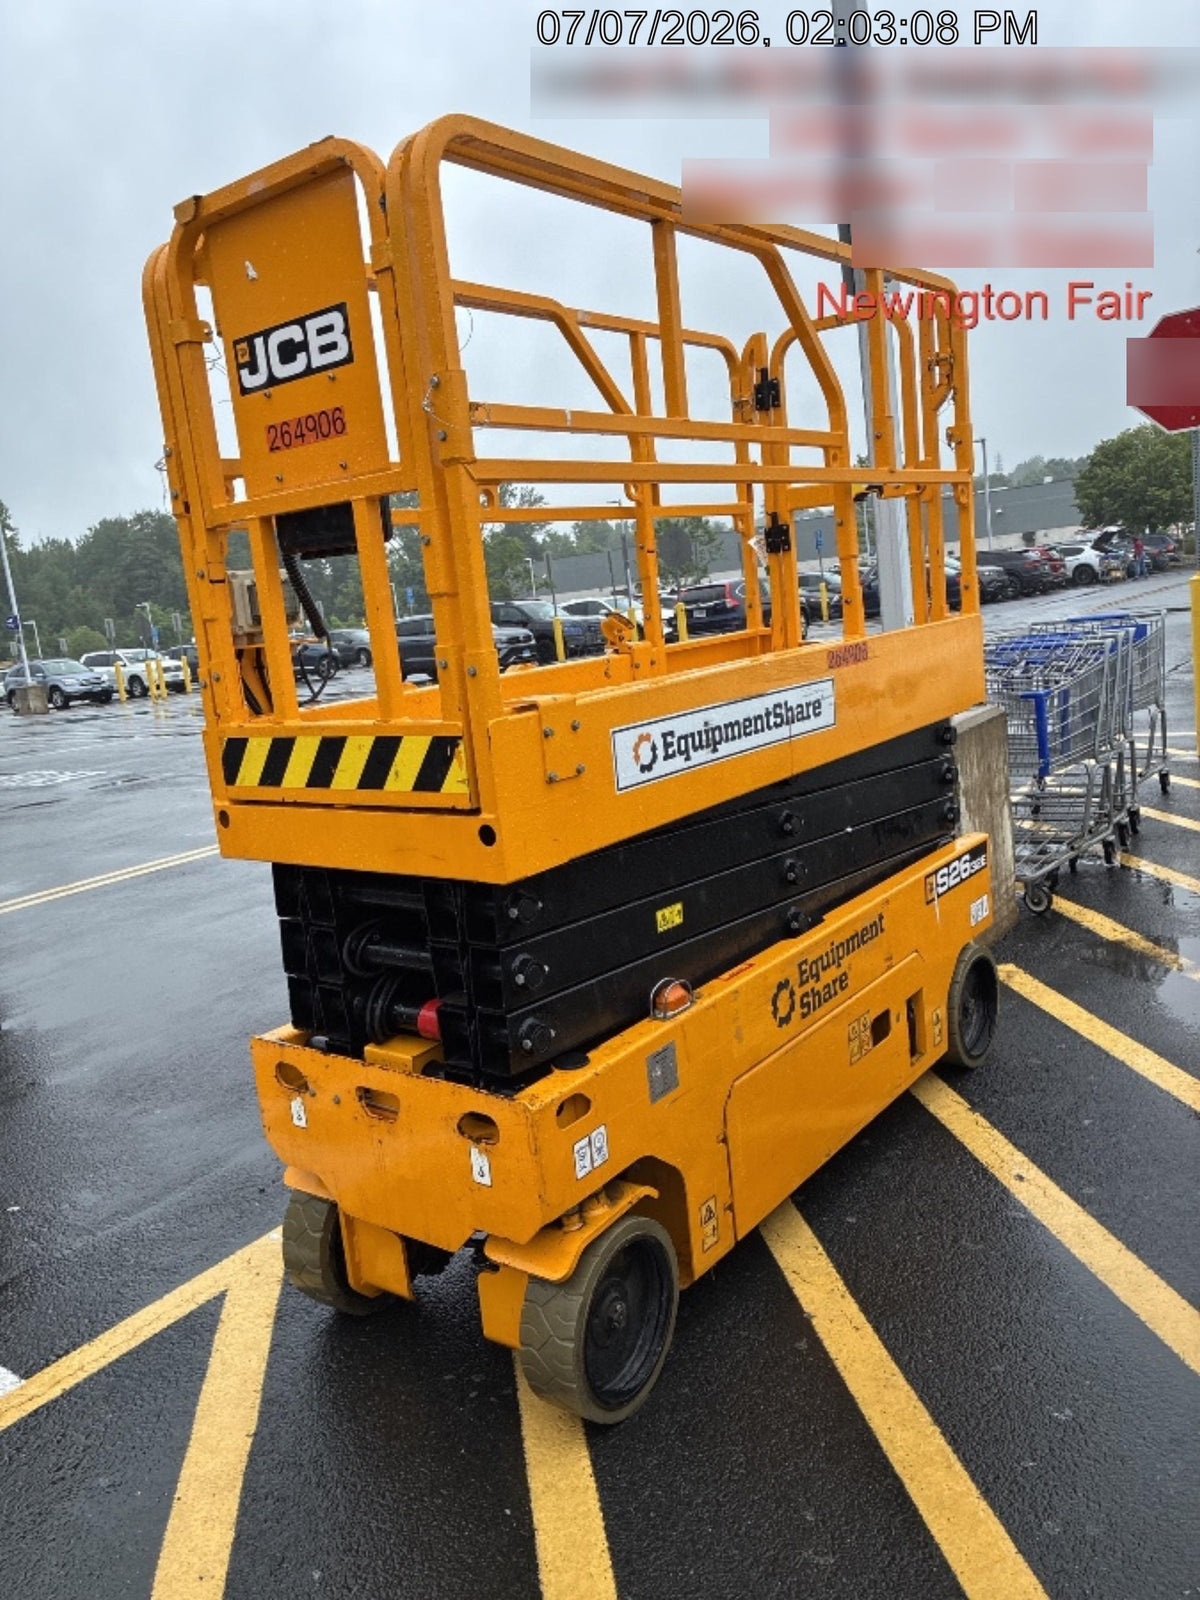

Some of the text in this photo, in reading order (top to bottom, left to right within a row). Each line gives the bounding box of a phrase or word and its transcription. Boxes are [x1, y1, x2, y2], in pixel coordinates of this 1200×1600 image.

[239, 310, 349, 389] JCB
[267, 406, 346, 452] 264906
[661, 697, 823, 763] EquipmentShare
[797, 911, 886, 988] Equipment
[799, 970, 849, 1019] Share
